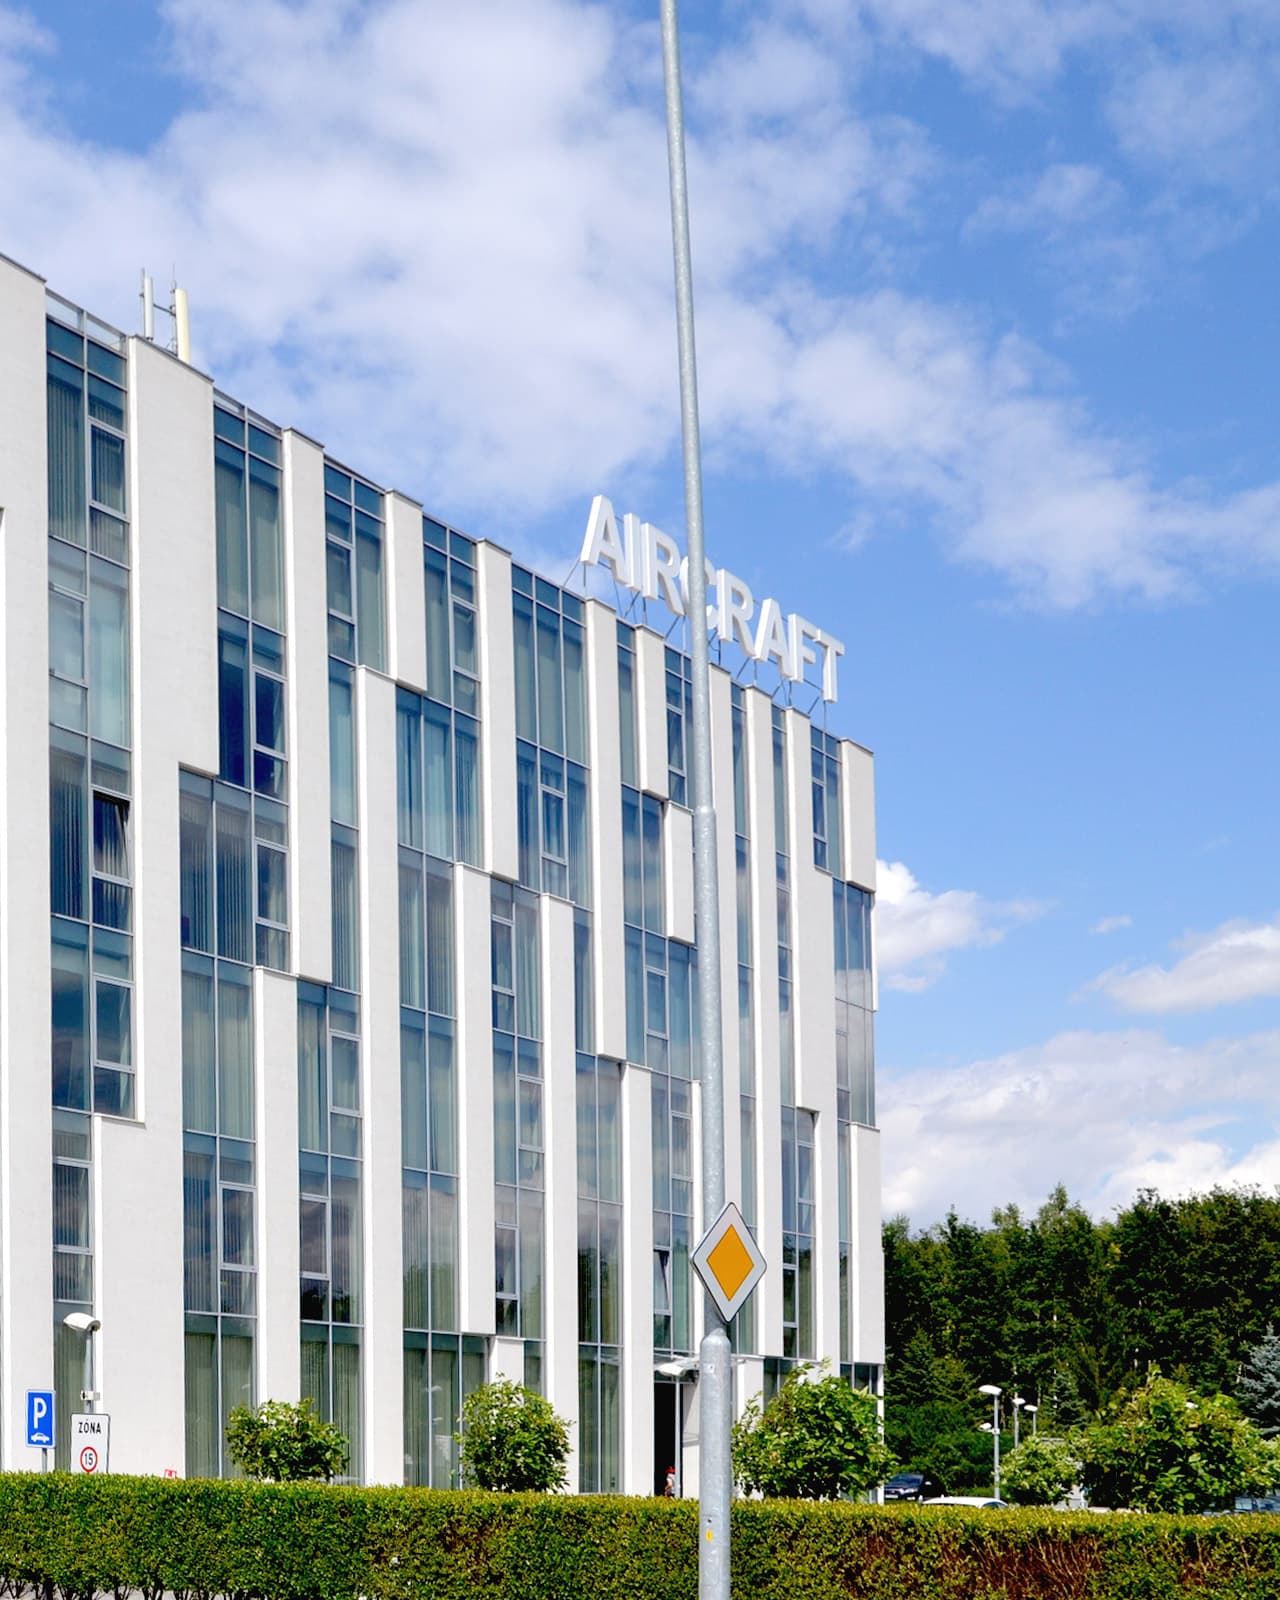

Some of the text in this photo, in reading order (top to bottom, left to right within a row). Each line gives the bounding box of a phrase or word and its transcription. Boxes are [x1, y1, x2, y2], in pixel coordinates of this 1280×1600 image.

[33, 1397, 47, 1429] P
[78, 1418, 101, 1434] ZÓNA
[84, 1453, 94, 1466] 15
